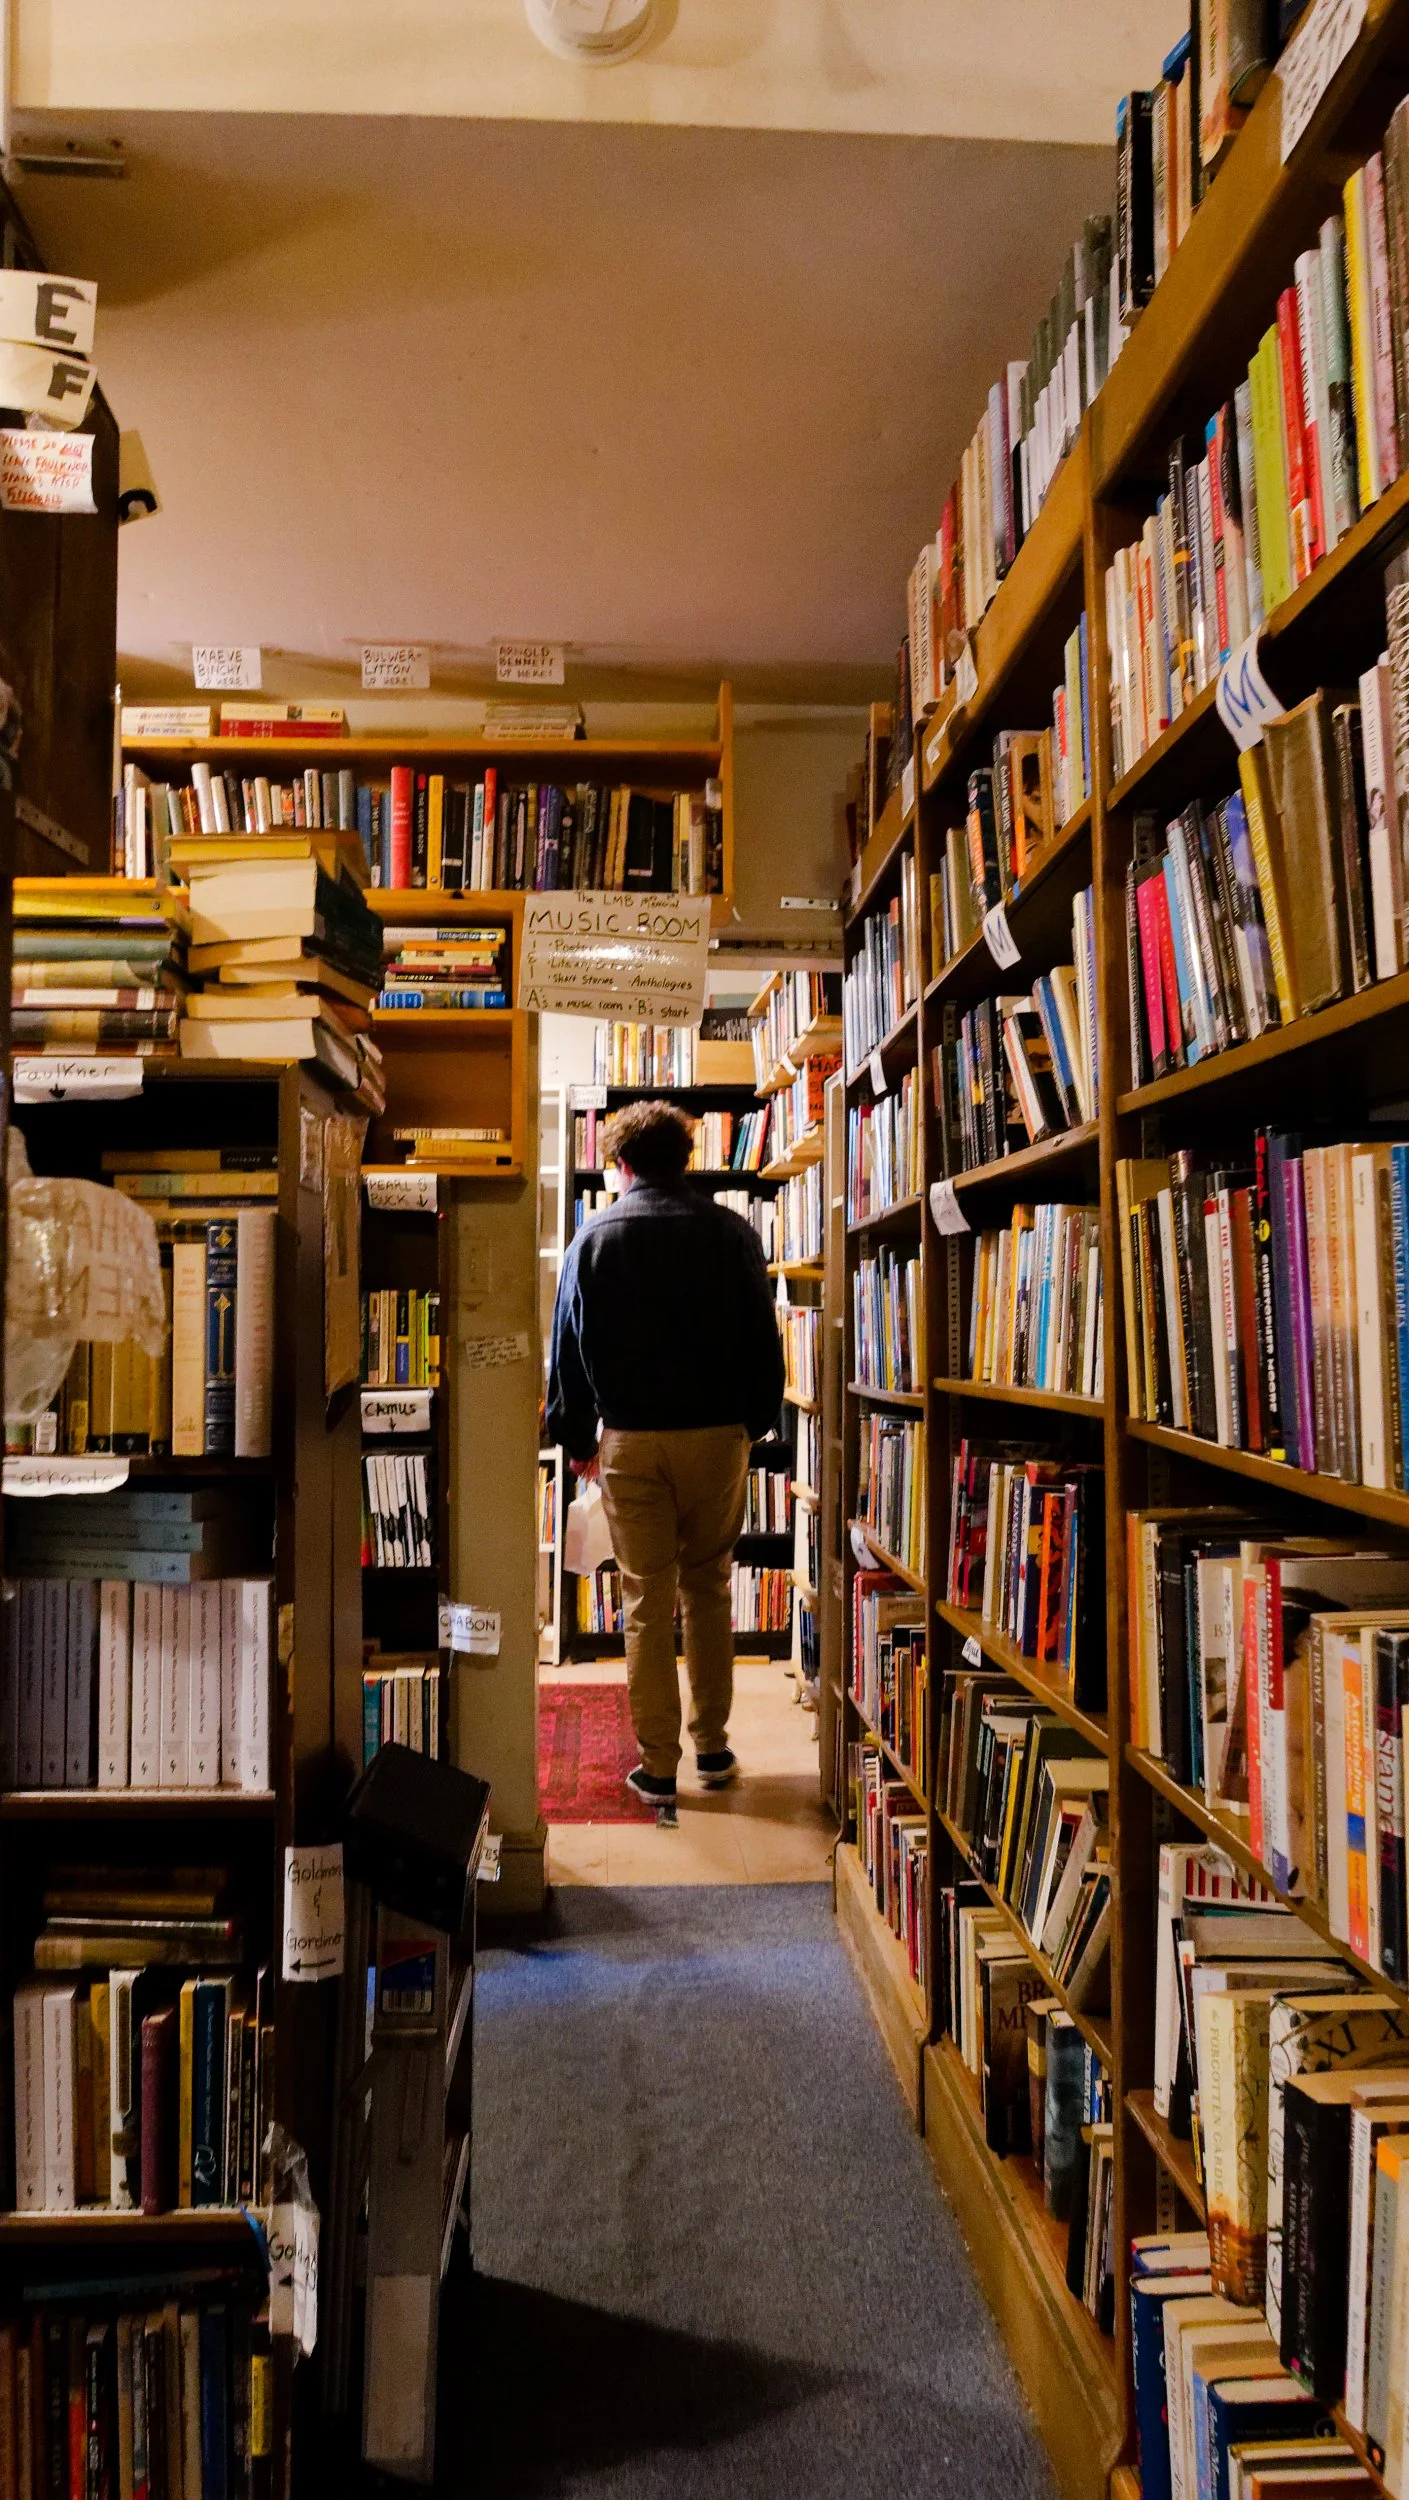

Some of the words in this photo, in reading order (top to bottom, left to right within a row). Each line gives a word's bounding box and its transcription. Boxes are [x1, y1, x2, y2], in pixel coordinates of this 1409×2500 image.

[35, 282, 90, 344] E
[48, 360, 89, 400] F
[197, 649, 242, 662] MAEVE
[364, 649, 422, 663] BULWER-
[198, 664, 242, 676] BINCHY
[365, 664, 411, 675] LYTTON
[1222, 652, 1266, 729] M
[1223, 848, 1237, 878] Swan
[577, 890, 594, 904] The
[603, 894, 634, 907] LMB
[1227, 880, 1241, 918] Green
[1261, 887, 1280, 936] ANGRY
[529, 910, 620, 932] MUSIC
[638, 913, 700, 937] ROOM
[582, 975, 615, 985] Stories
[631, 975, 693, 990] Anthologies
[599, 1001, 623, 1010] room
[660, 1006, 690, 1018] start
[16, 1061, 117, 1081] Faulkner
[369, 1179, 411, 1192] PEARL
[1220, 1224, 1230, 1250] THE
[1309, 1237, 1319, 1307] MOORE
[1330, 1236, 1341, 1311] MOORE
[1222, 1256, 1234, 1340] STATEMENT
[1262, 1253, 1274, 1356] CHRISTOPHER
[1268, 1361, 1277, 1413] MOORE
[1232, 1399, 1240, 1436] MOORE
[440, 1613, 495, 1632] CHABON
[1312, 1628, 1321, 1645] IN
[1350, 1691, 1363, 1812] Astonishing
[288, 1857, 343, 1883] Goldman
[286, 1928, 344, 1953] Gordimer
[1209, 2027, 1223, 2128] FORGOTTEN
[1212, 2132, 1225, 2202] GARDEN
